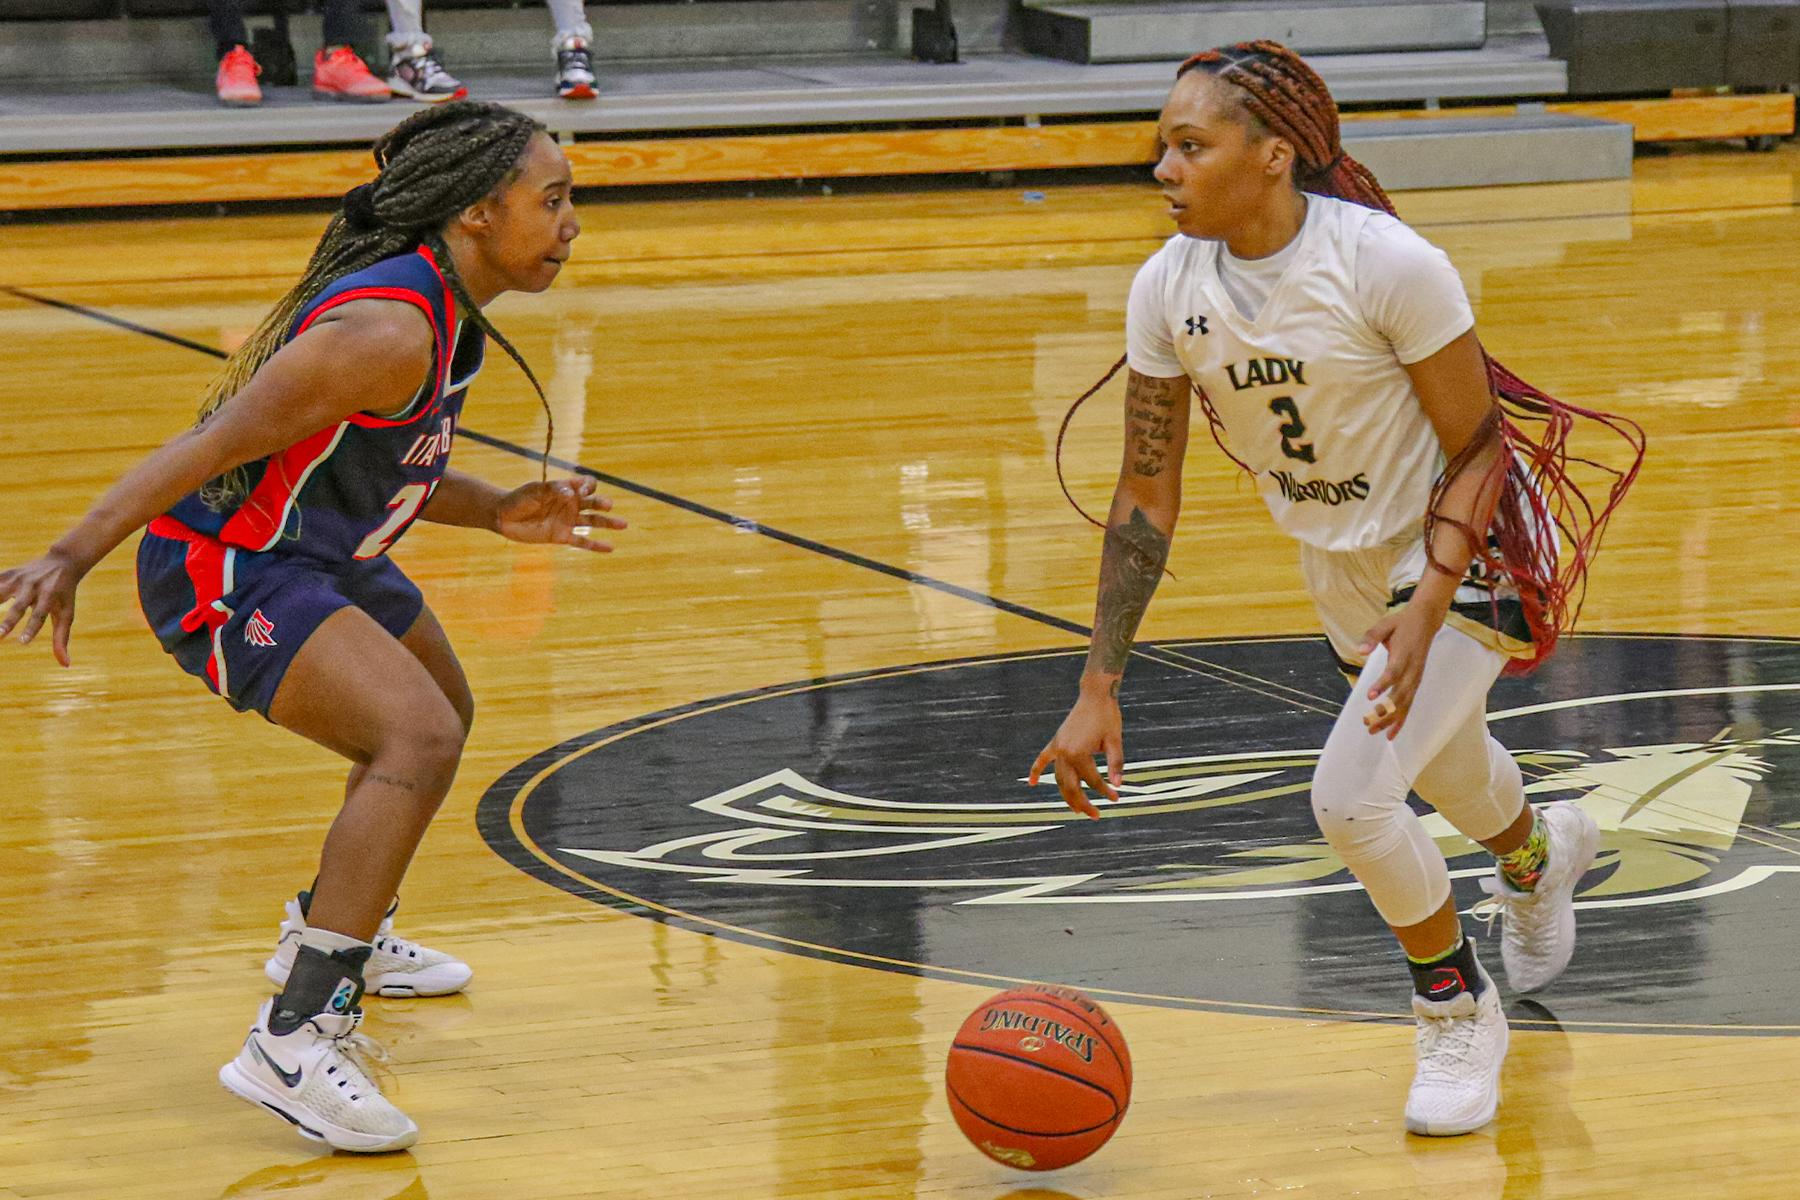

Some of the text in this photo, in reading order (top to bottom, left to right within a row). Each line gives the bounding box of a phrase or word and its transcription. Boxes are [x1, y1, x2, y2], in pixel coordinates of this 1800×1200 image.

[1224, 357, 1310, 391] LADY
[1268, 396, 1318, 464] 2
[1268, 470, 1371, 506] WARRIORS
[352, 477, 441, 561] 2
[979, 1008, 1100, 1063] SPALDING
